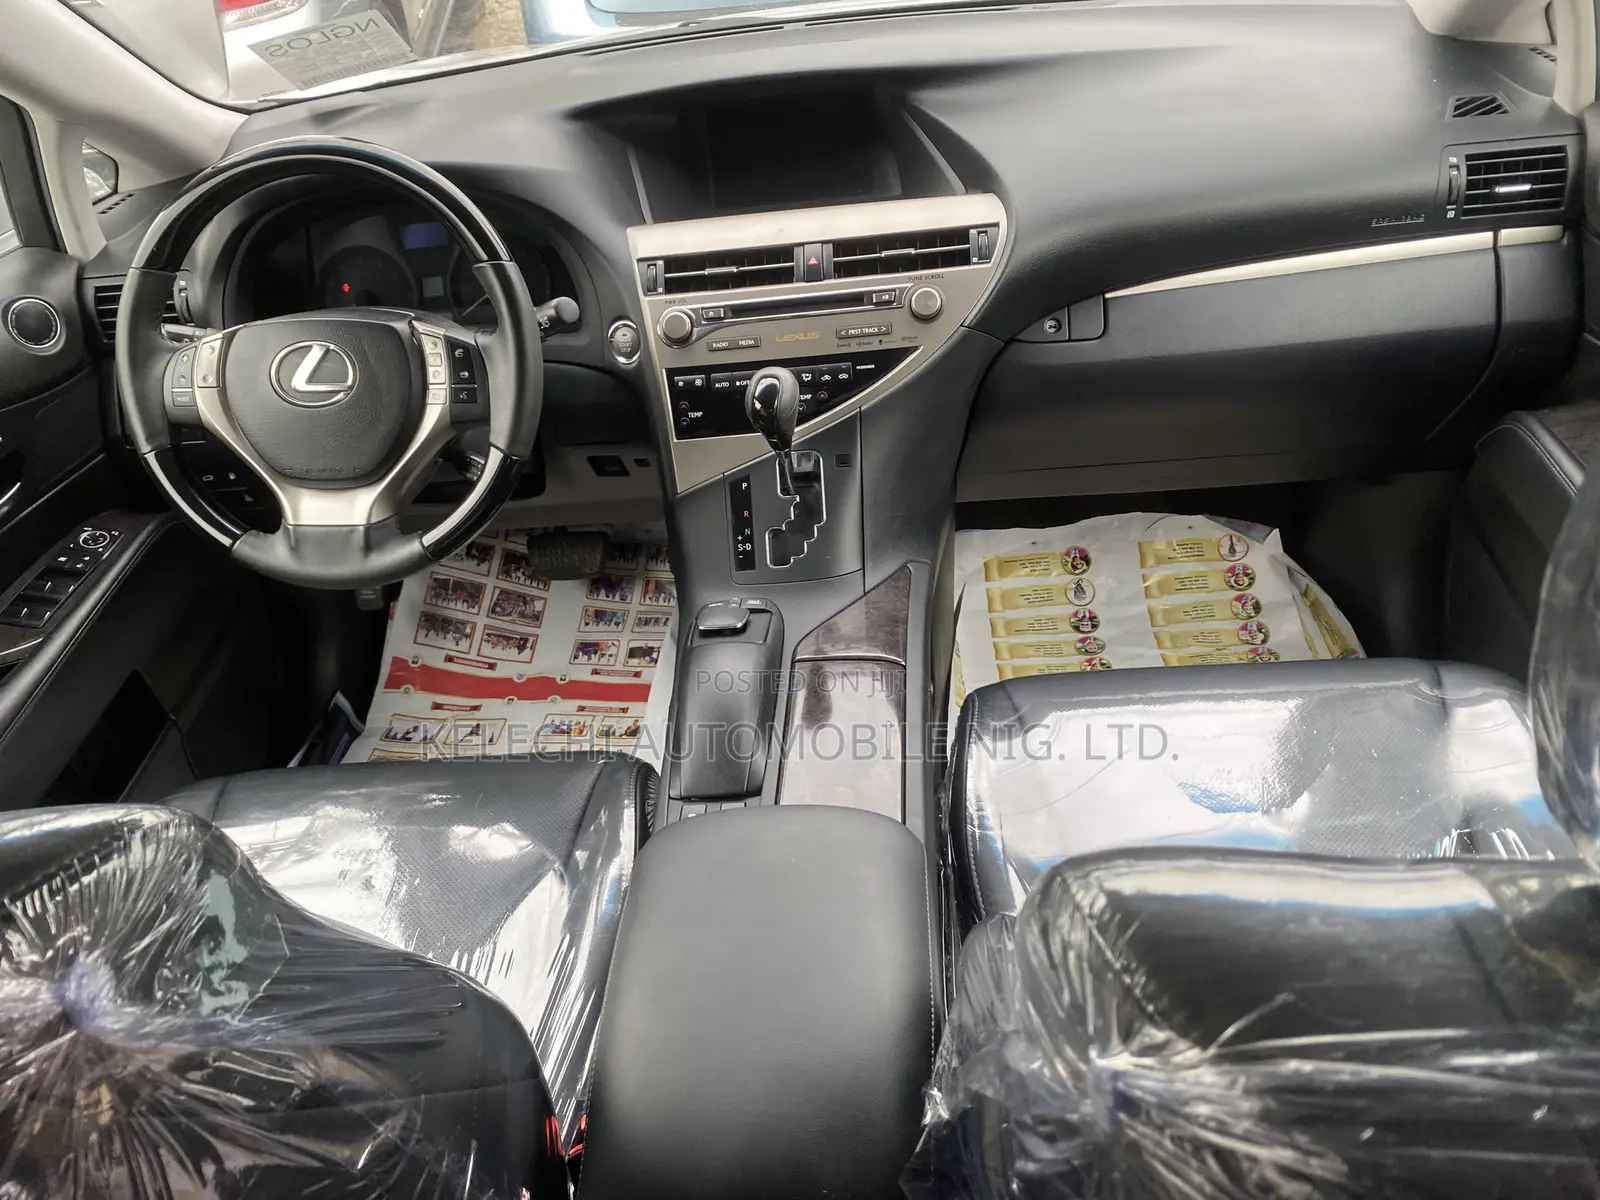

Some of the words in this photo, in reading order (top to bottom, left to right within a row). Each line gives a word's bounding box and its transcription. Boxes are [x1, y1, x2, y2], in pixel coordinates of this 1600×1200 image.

[776, 331, 821, 343] LEXUS
[742, 482, 748, 490] P
[743, 510, 750, 518] R
[744, 528, 751, 536] N
